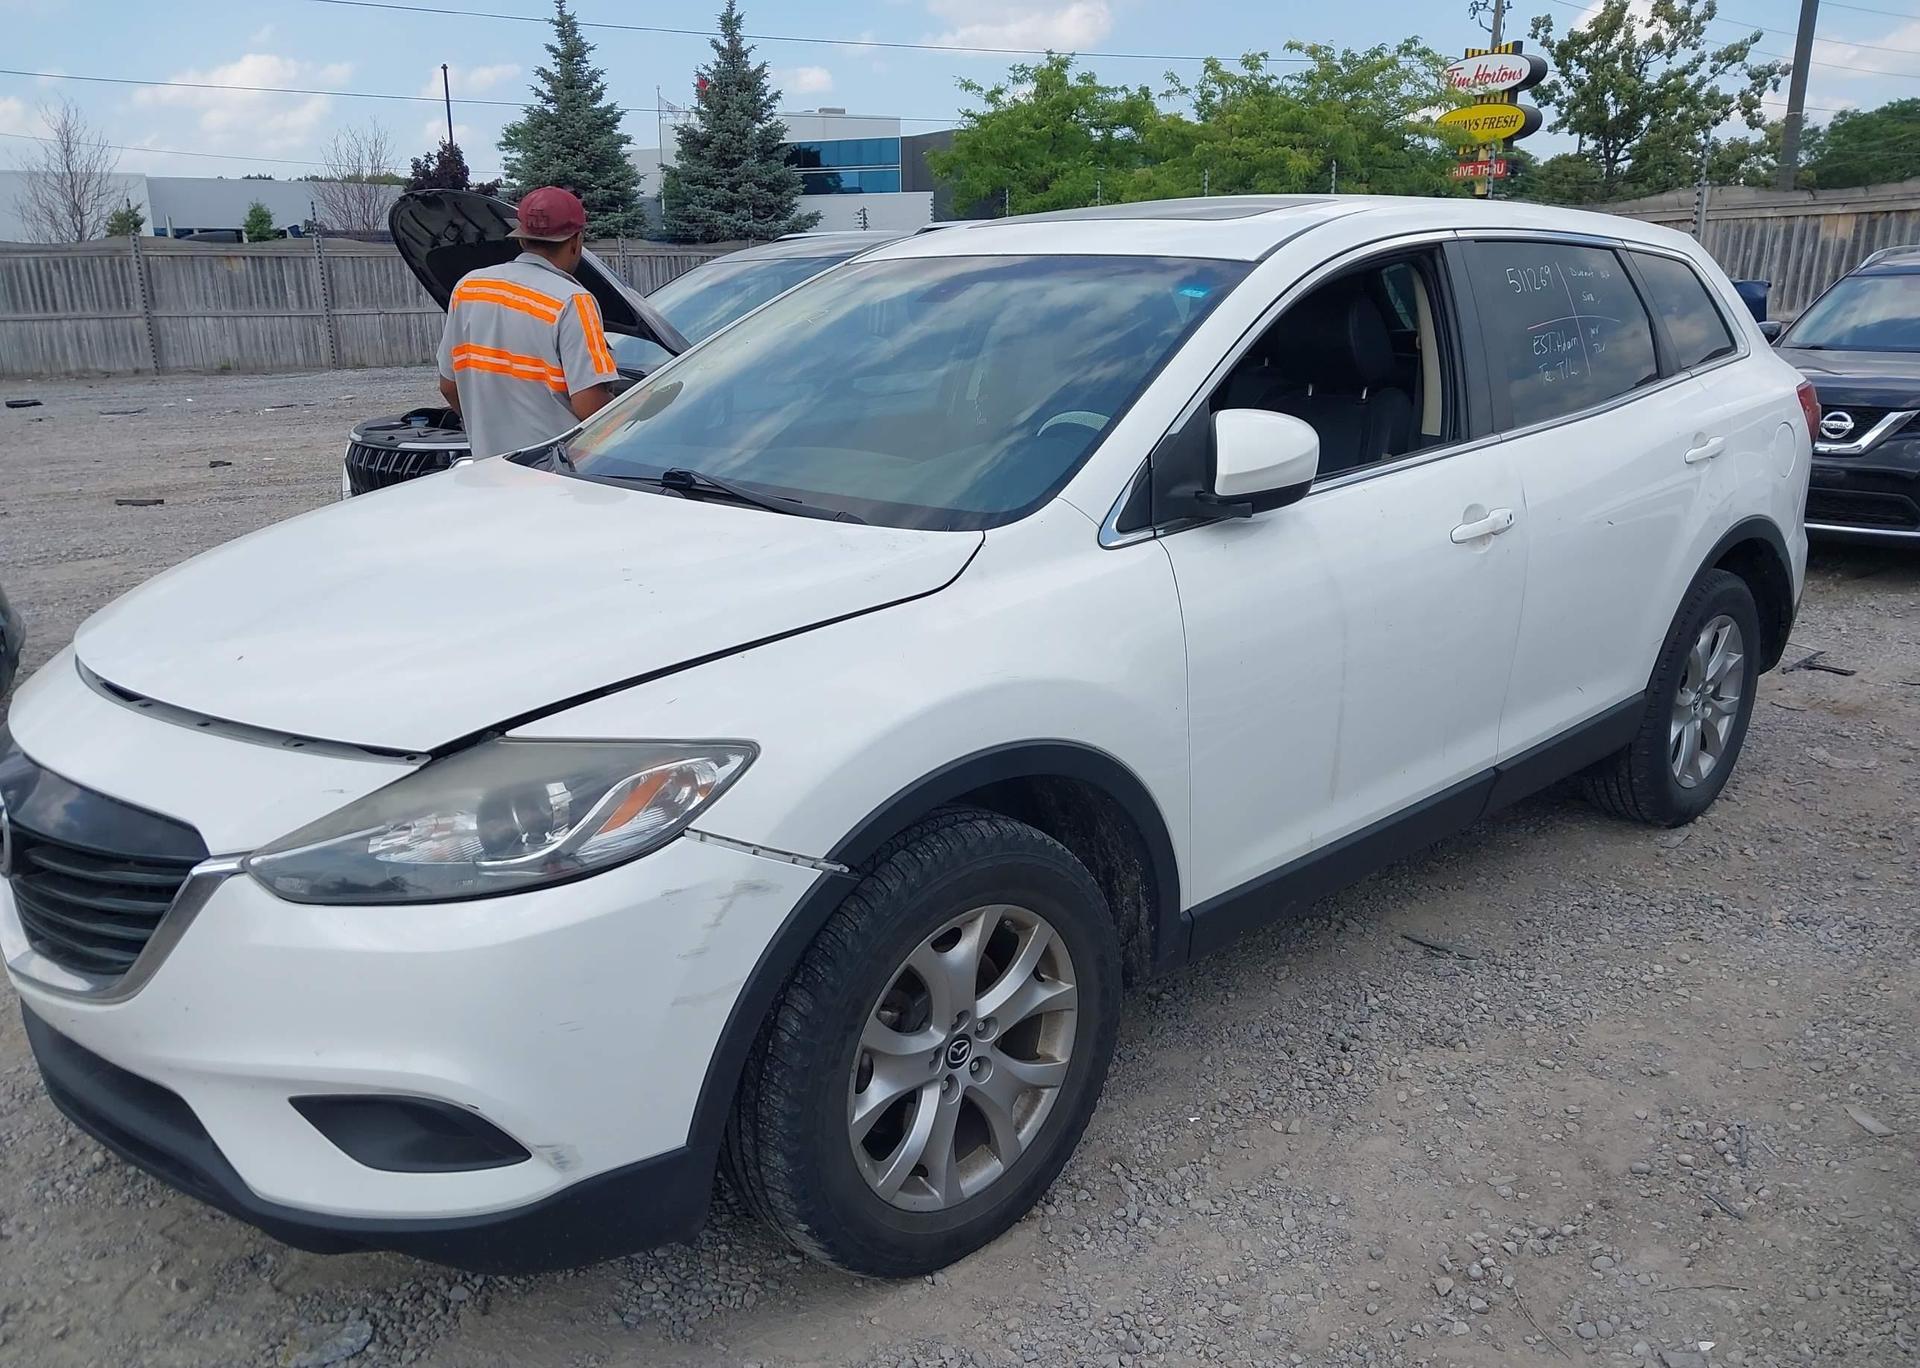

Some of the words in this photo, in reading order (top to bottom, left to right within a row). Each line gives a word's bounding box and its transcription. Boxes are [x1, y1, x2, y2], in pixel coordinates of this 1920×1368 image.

[1447, 67, 1472, 87] Tim
[1474, 64, 1523, 84] Hortons
[1481, 115, 1519, 130] FRESH
[1506, 265, 1554, 293] 511269
